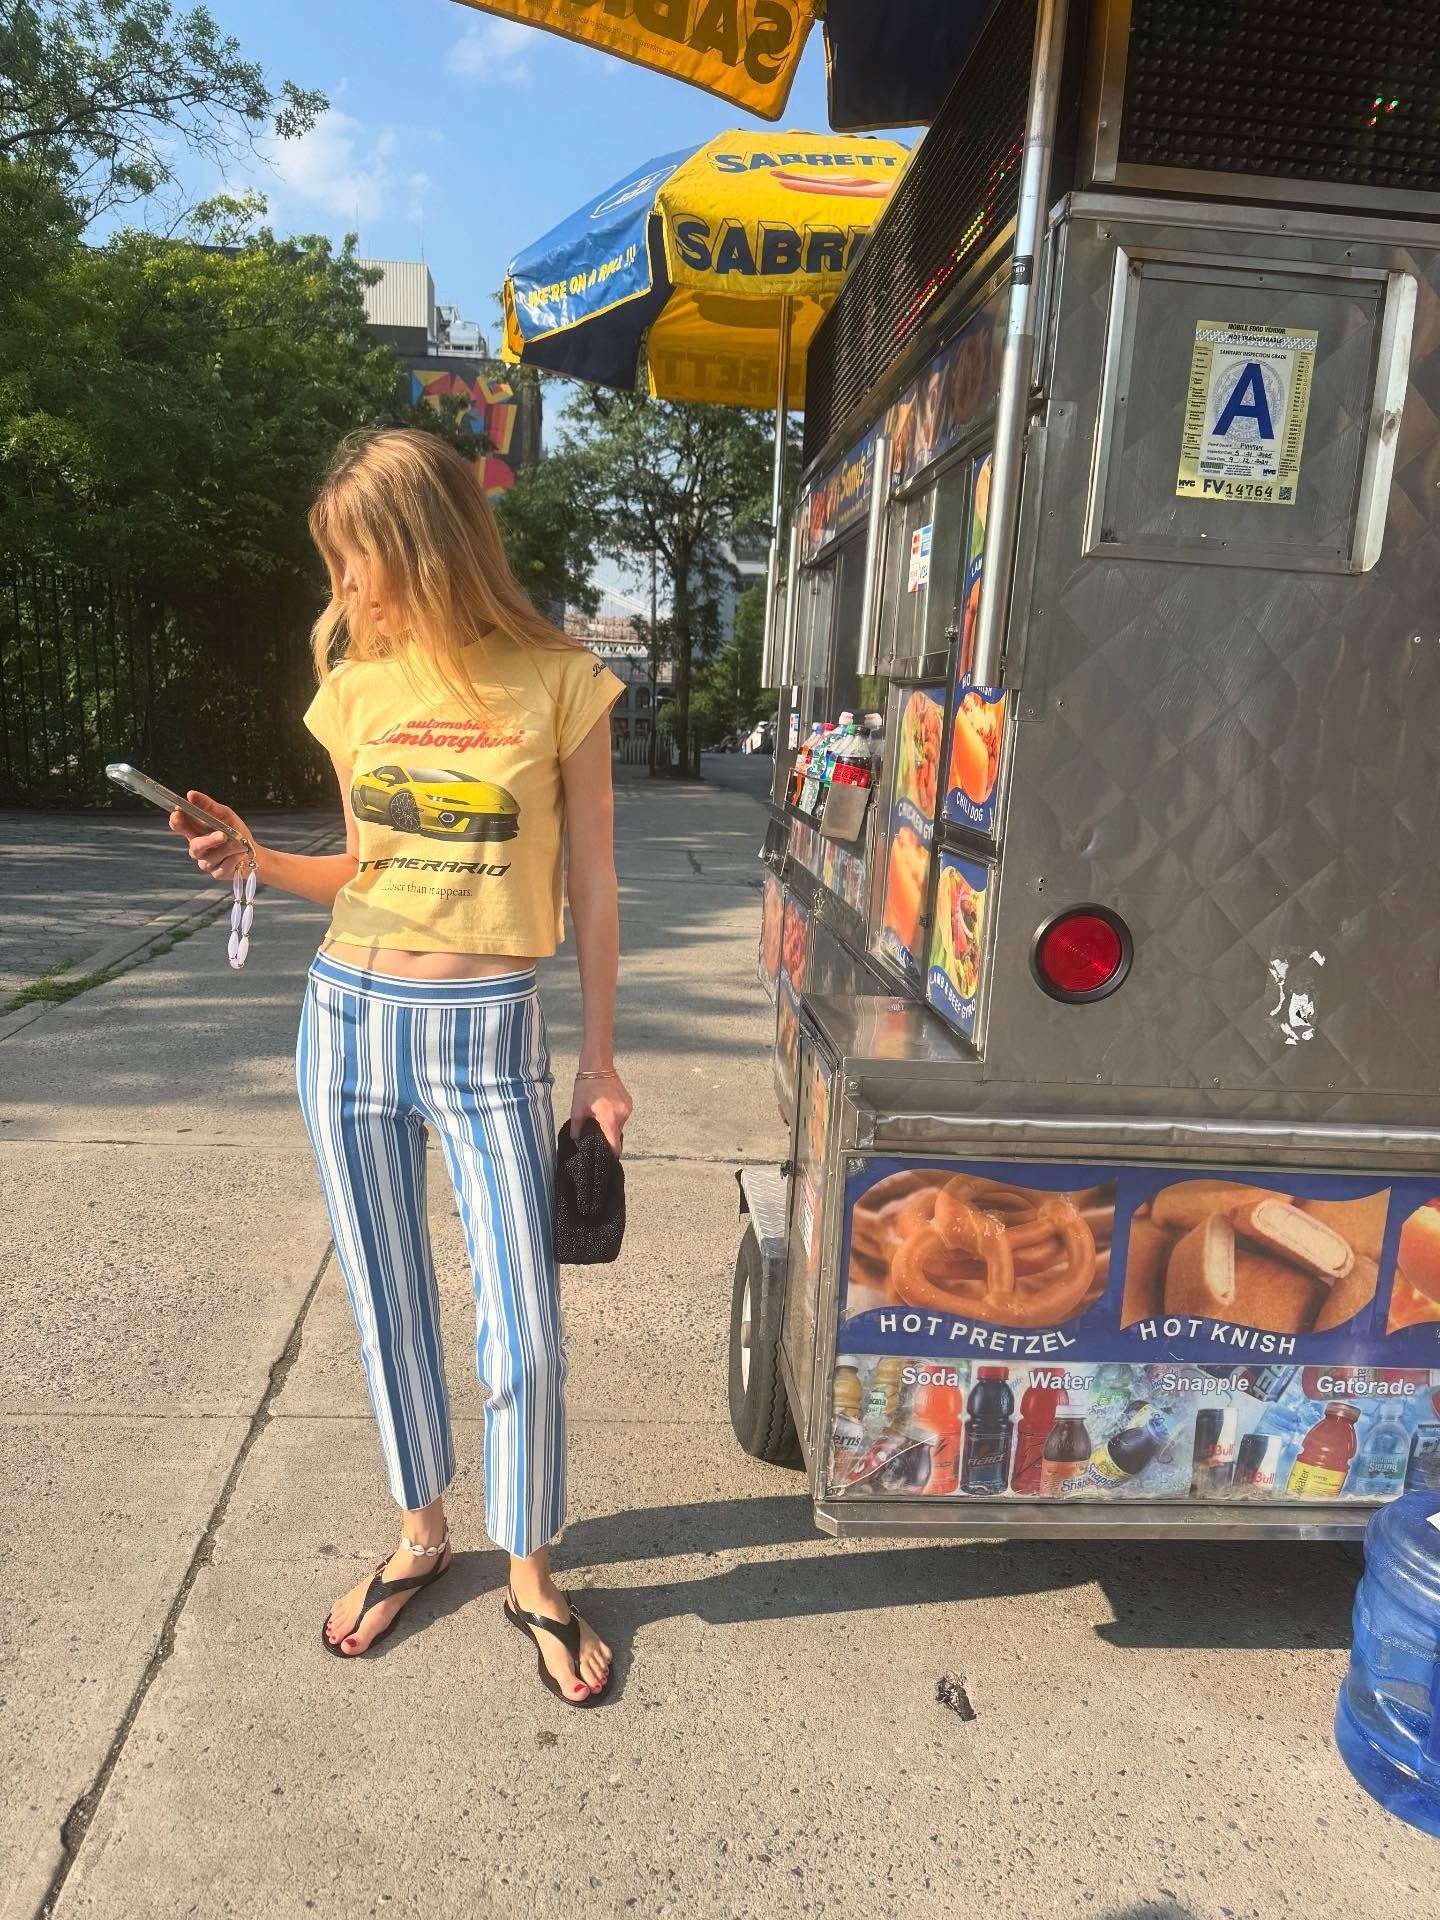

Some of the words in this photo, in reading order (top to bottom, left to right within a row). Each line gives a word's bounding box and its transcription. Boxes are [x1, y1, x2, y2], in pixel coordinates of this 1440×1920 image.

[706, 150, 898, 173] SABRETT
[569, 272, 587, 295] ON
[1228, 323, 1249, 333] MOBILE
[1249, 325, 1264, 333] FOOD
[1265, 327, 1286, 335] VENDOR
[1220, 349, 1242, 357] SANITARY
[1242, 351, 1271, 359] INSPECTION
[1212, 363, 1274, 439] A
[406, 718, 491, 731] automobi
[970, 807, 983, 822] DOG
[359, 856, 512, 877] TEMERARIO
[407, 881, 427, 895] than
[436, 887, 473, 900] appears.
[880, 1314, 942, 1336] HOT
[949, 1322, 1076, 1354] PRETZEL
[1139, 1318, 1202, 1341] HOT
[1210, 1323, 1296, 1356] KNISH
[902, 1366, 959, 1387] Soda
[1029, 1371, 1094, 1391] Water
[1162, 1373, 1250, 1395] Snapple
[1316, 1375, 1415, 1397] Gatorade
